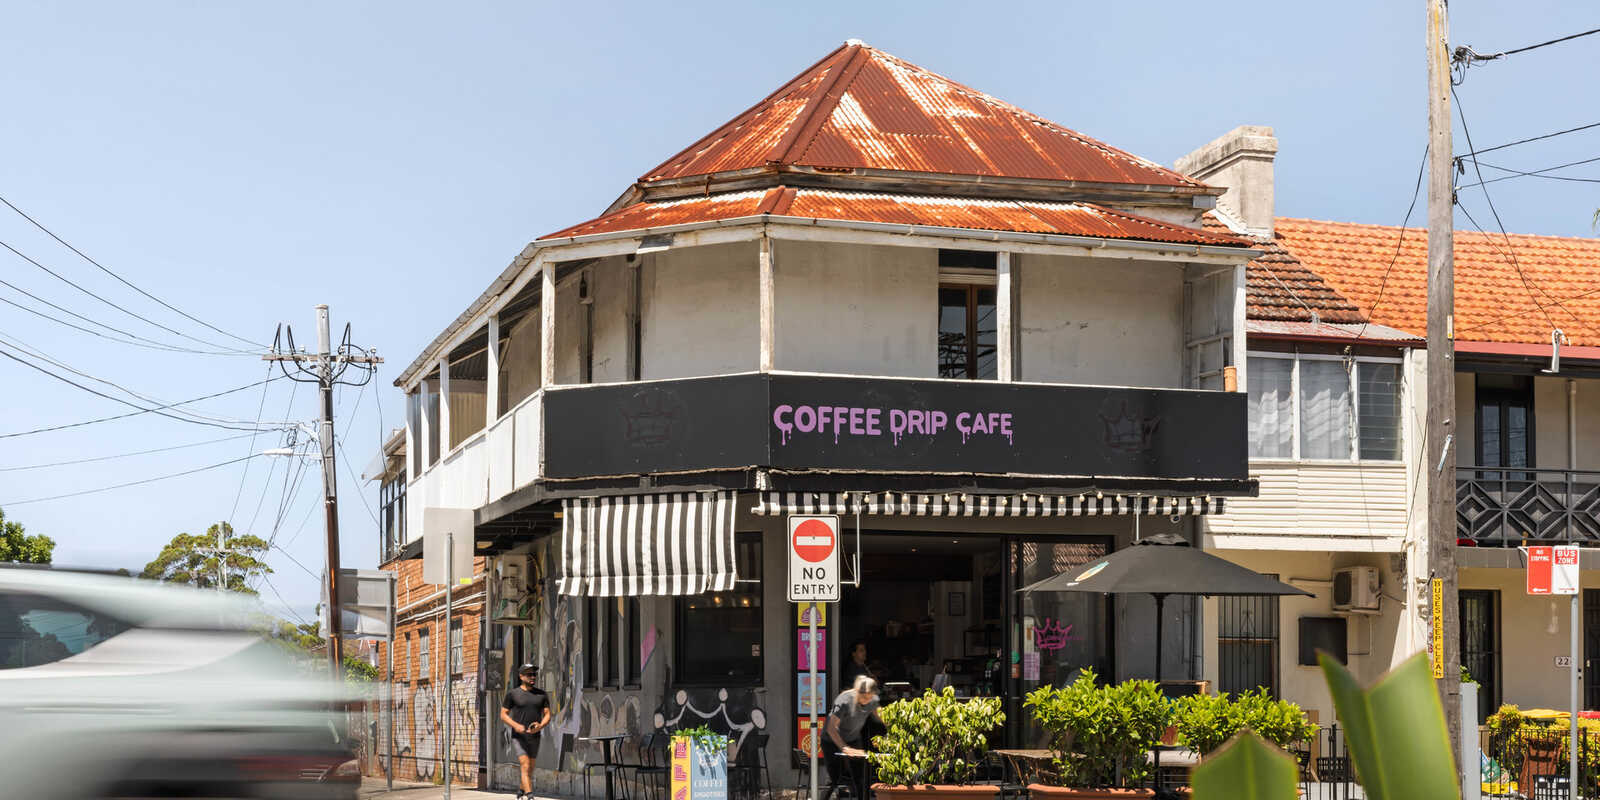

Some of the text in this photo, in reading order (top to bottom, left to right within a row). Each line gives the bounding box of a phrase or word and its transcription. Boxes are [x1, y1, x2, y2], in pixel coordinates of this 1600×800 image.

[773, 404, 1013, 446] COFFEE DRIP CAFE
[802, 567, 826, 580] NO
[793, 584, 834, 595] ENTRY
[1434, 616, 1442, 641] KEEP
[1434, 645, 1442, 677] CLEAR
[694, 779, 723, 788] COFFEE
